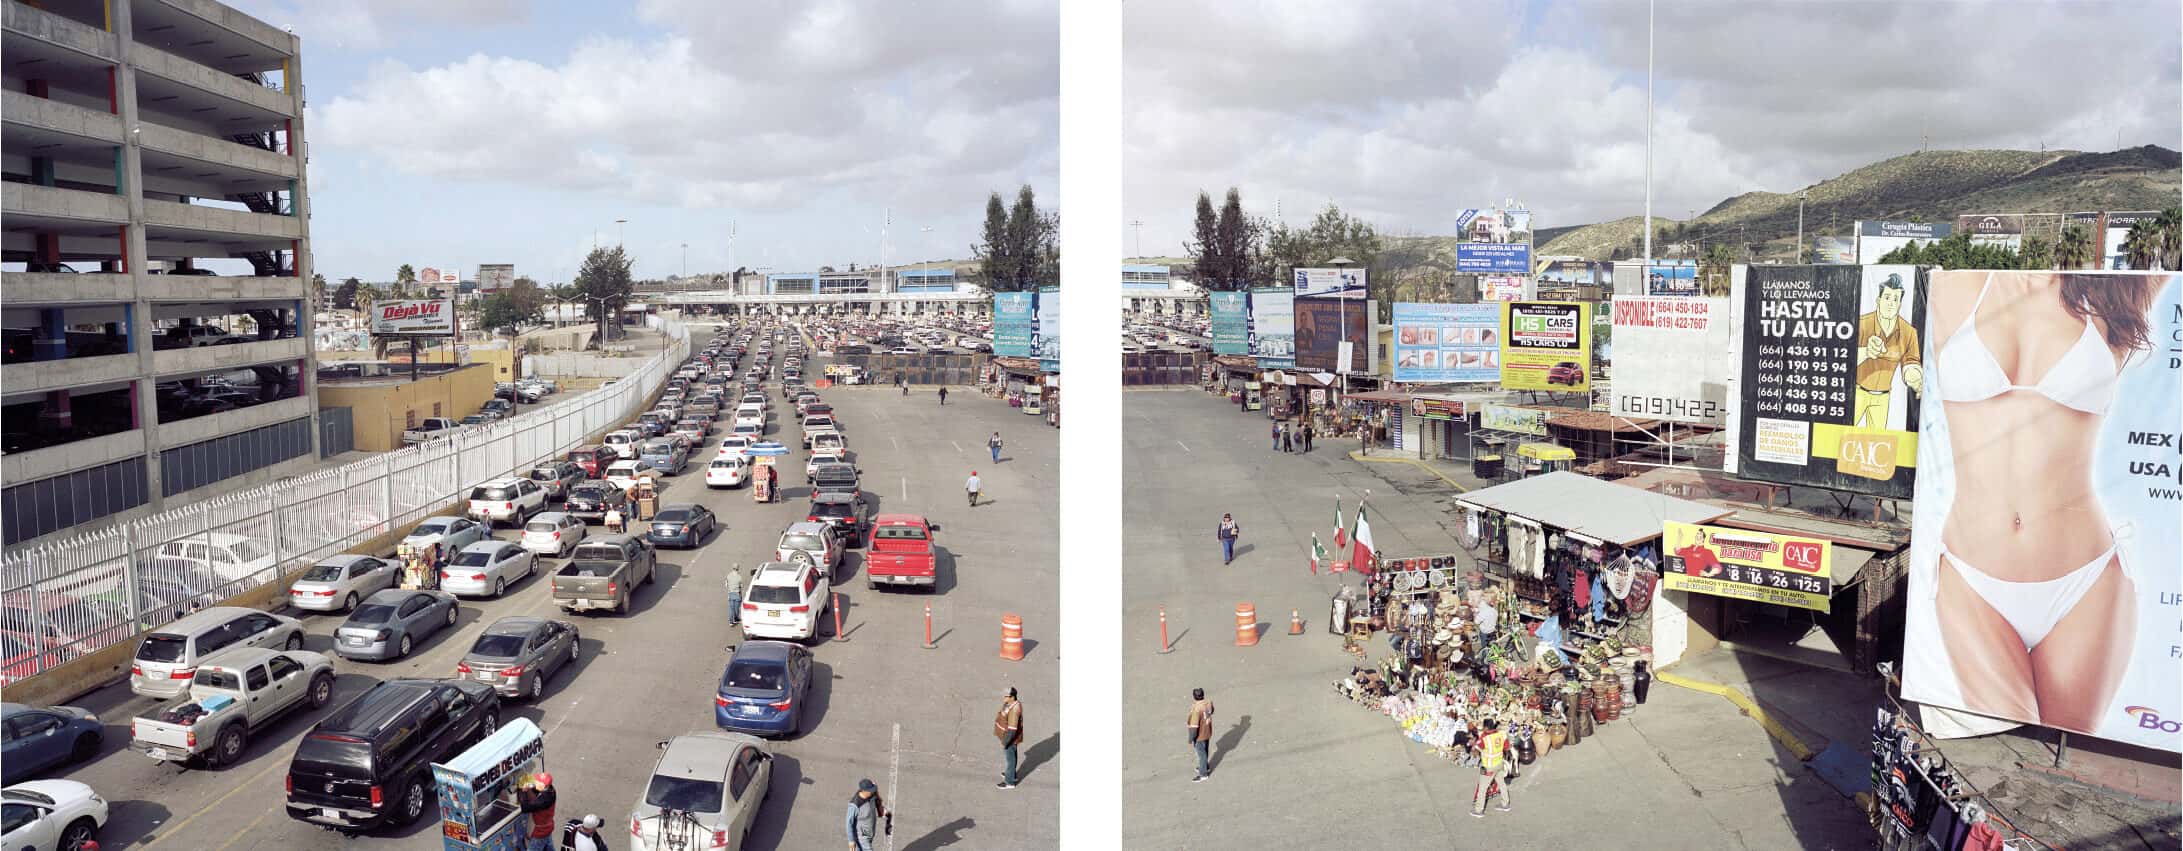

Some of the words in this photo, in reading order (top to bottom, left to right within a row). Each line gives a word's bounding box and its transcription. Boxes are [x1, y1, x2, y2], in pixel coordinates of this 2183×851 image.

[1762, 290, 1769, 298] Y
[1770, 290, 1781, 298] LO
[1784, 290, 1831, 299] LLEVAMOS
[1614, 300, 1655, 327] DISPONIBLE
[1655, 302, 1674, 314] (664)
[1675, 303, 1708, 314] 450-1834
[1761, 300, 1830, 319] HASTA
[1520, 317, 1540, 332] HS
[1546, 318, 1574, 328] CARS
[1655, 316, 1673, 329] (619)
[1760, 319, 1786, 337] TU
[1791, 320, 1854, 340] AUTO
[1759, 345, 1784, 357] (664)
[1786, 346, 1810, 356] 436
[1812, 347, 1827, 357] 91
[1833, 347, 1848, 358] 12
[1758, 359, 1784, 371] (664)
[1787, 360, 1809, 370] 190
[1812, 361, 1828, 372] 95
[1831, 362, 1847, 373] 94
[1758, 373, 1783, 385] (664)
[1785, 374, 1808, 385] 436
[1811, 375, 1827, 386] 38
[1830, 377, 1845, 387] 81
[1757, 387, 1782, 399] (664)
[1785, 388, 1807, 399] 436
[1810, 390, 1826, 400] 93
[1829, 392, 1846, 402] 43
[1757, 401, 1782, 413] (664)
[1784, 403, 1807, 414] 408
[1810, 404, 1826, 415] 59
[1829, 406, 1845, 417] 55
[2127, 431, 2174, 447] MEX
[1842, 439, 1891, 468] CAIC
[2128, 461, 2172, 477] USA
[1785, 544, 1819, 565] CAIC
